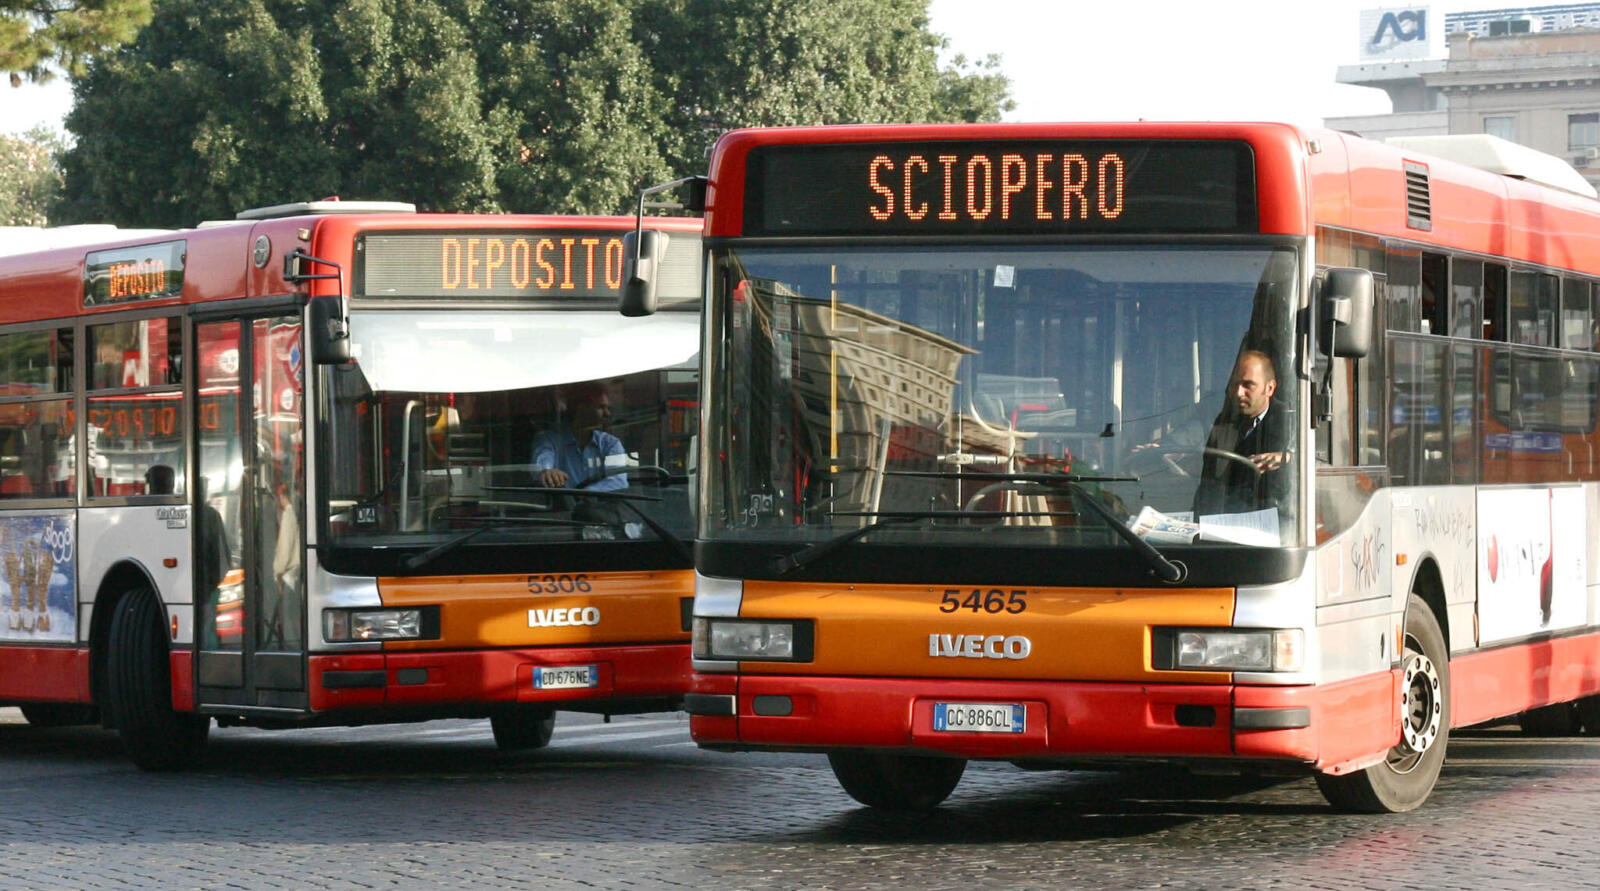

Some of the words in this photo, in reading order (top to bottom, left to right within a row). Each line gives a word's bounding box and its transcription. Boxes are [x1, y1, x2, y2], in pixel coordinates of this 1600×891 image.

[869, 154, 1124, 220] SCIOPERO
[441, 238, 625, 290] DEPOSITO
[109, 259, 165, 297] DEPOSITO
[527, 574, 592, 594] 5306
[939, 589, 1027, 614] 5465
[527, 606, 601, 628] IVECO
[929, 633, 1032, 660] IVECO
